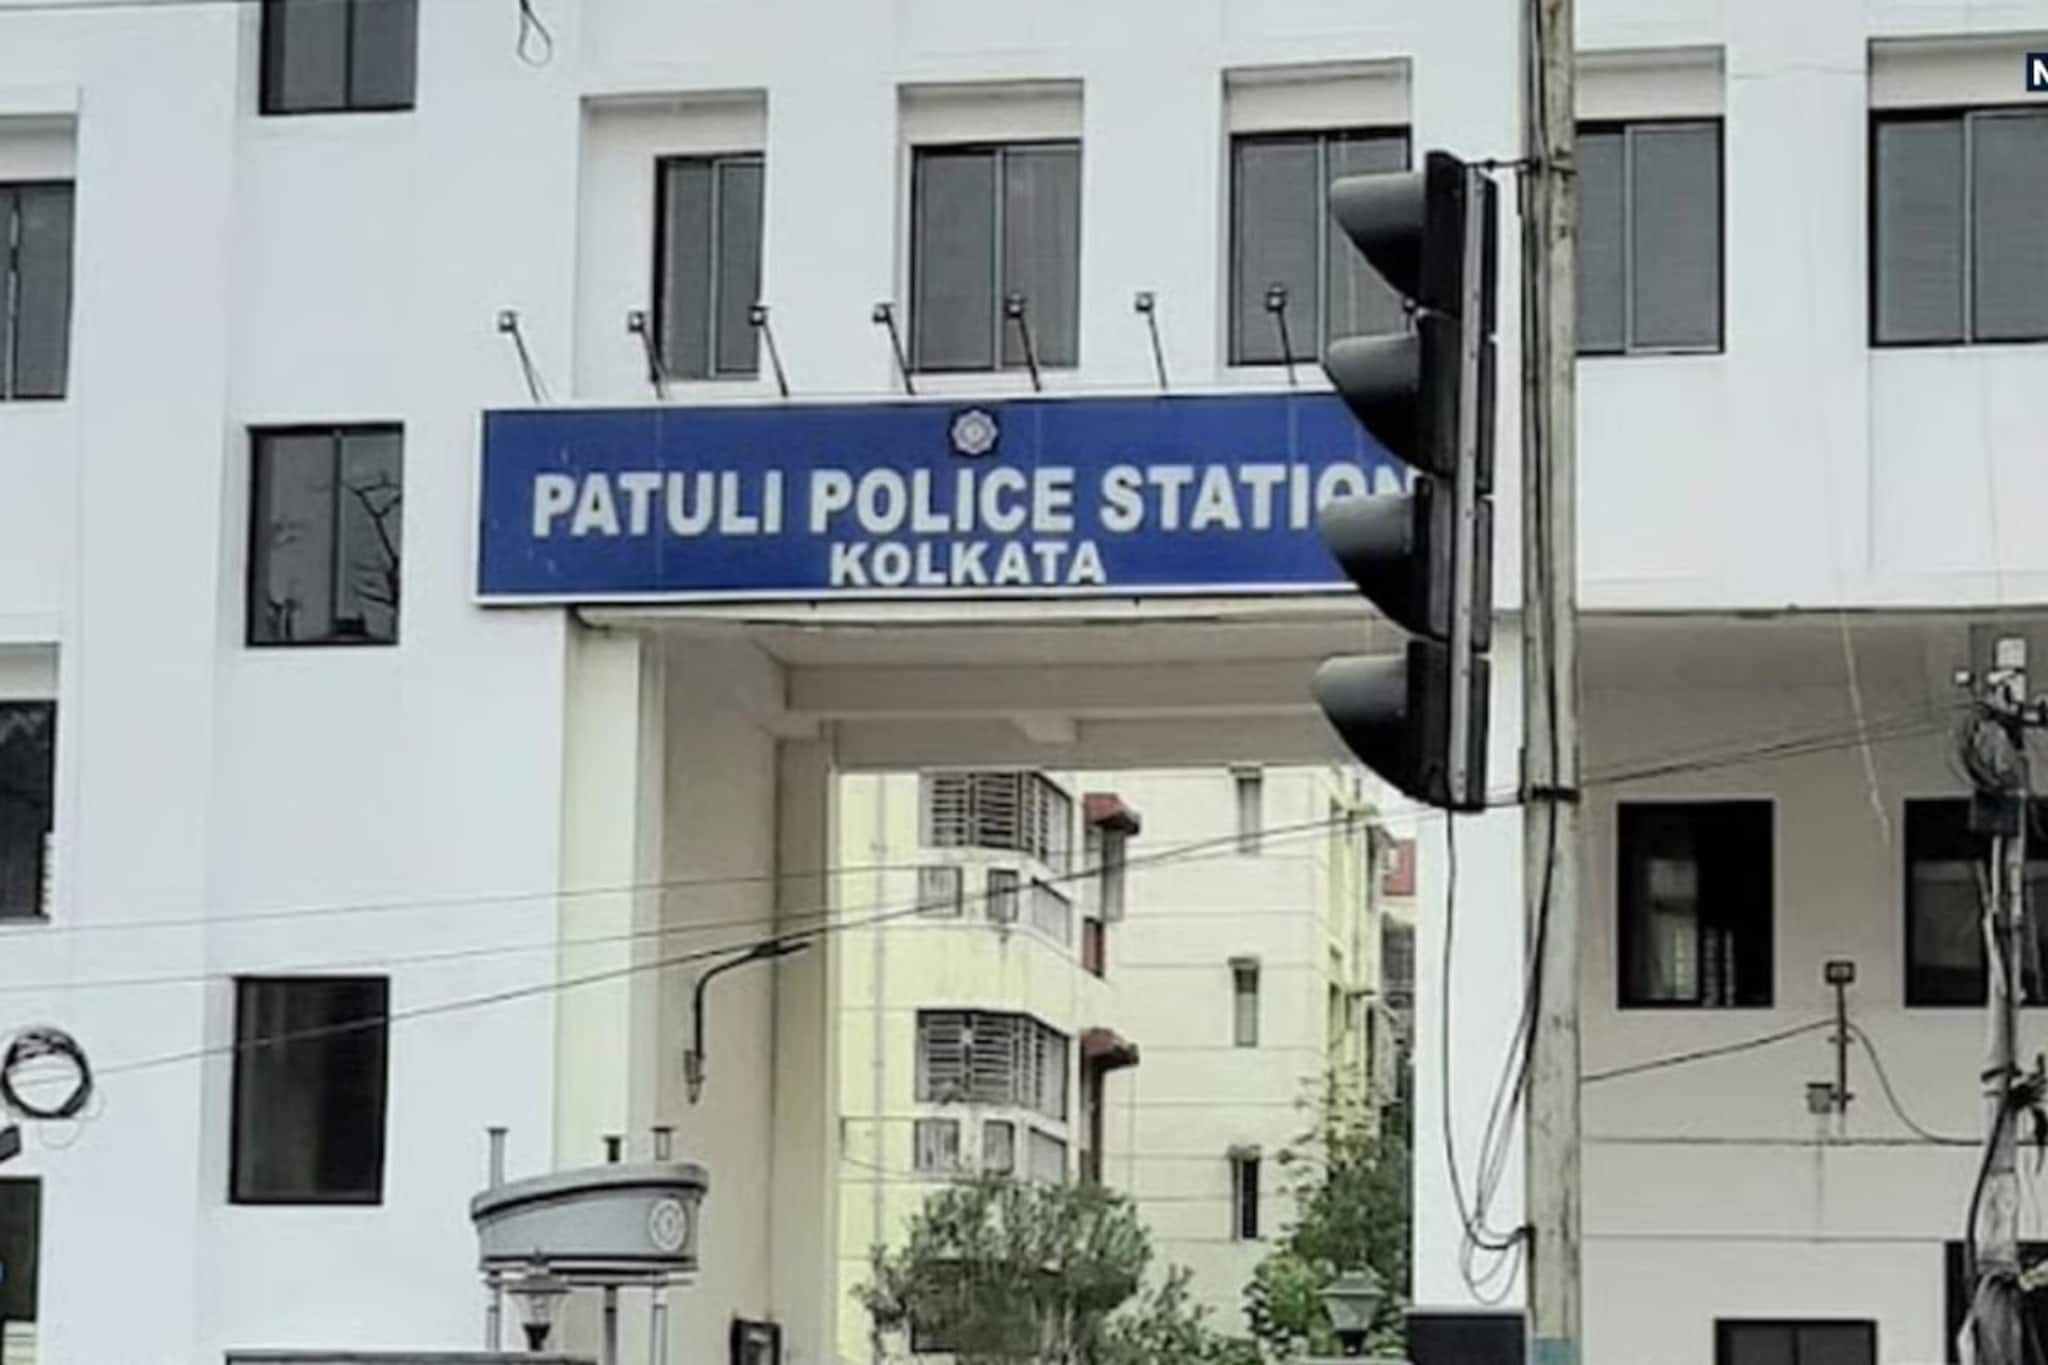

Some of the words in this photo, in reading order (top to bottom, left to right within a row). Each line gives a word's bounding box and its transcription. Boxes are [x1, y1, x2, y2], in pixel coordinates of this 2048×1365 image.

[532, 470, 783, 538] PATULI
[809, 467, 1076, 535] POLICE
[829, 540, 1107, 587] KOLKATA
